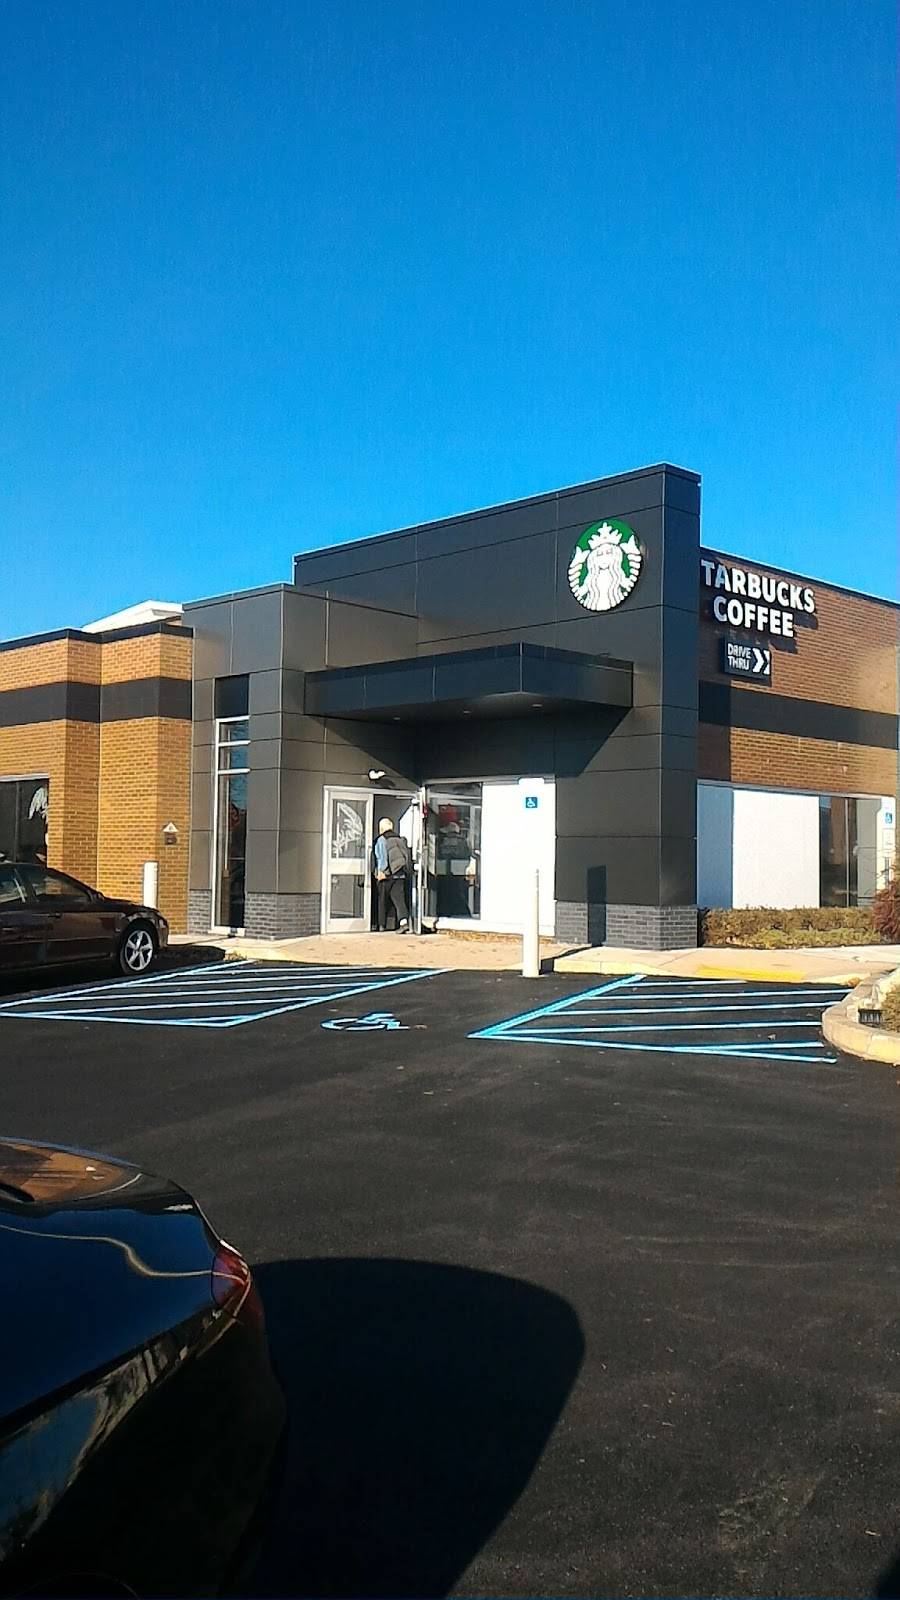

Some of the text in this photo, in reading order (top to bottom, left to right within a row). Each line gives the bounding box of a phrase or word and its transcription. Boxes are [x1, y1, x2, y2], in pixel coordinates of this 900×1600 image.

[701, 559, 815, 613] TARBUCKS
[714, 596, 794, 637] COFFEE
[727, 643, 751, 659] DRIVE
[727, 655, 750, 670] THRU
